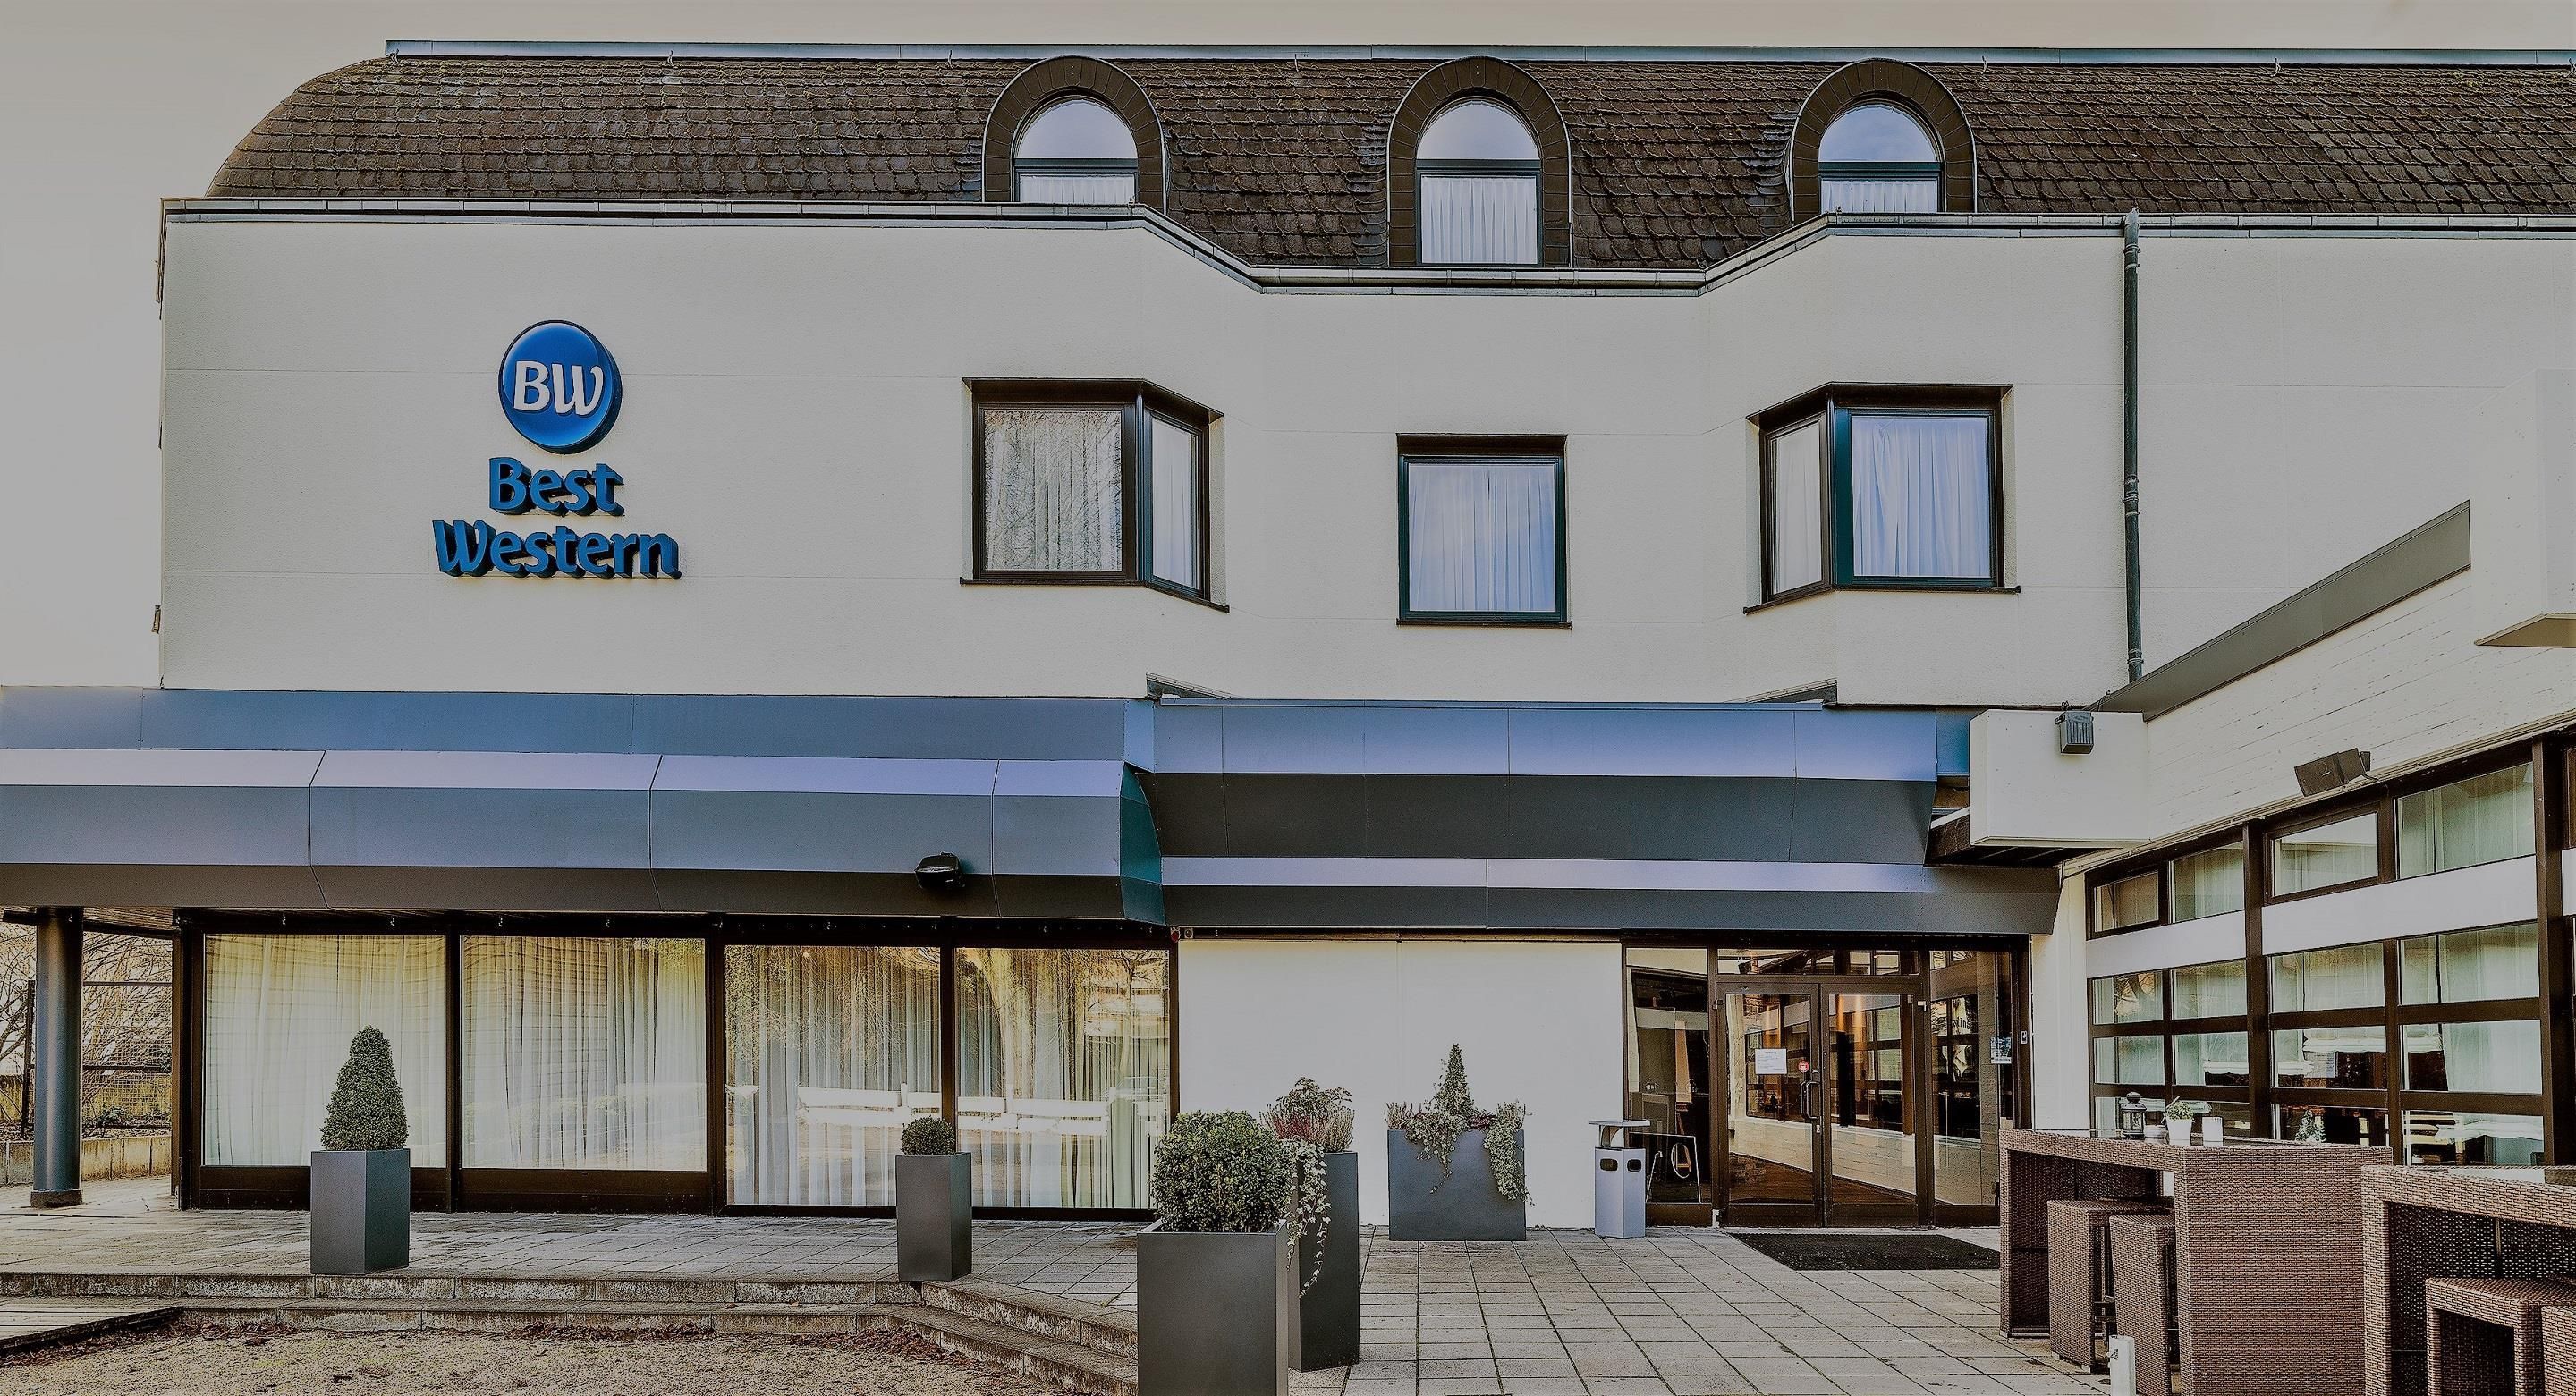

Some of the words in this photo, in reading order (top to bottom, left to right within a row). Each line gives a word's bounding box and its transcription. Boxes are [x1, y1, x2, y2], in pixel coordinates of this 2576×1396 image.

[513, 360, 604, 416] BW
[488, 456, 624, 516] Best
[432, 519, 682, 579] Western
